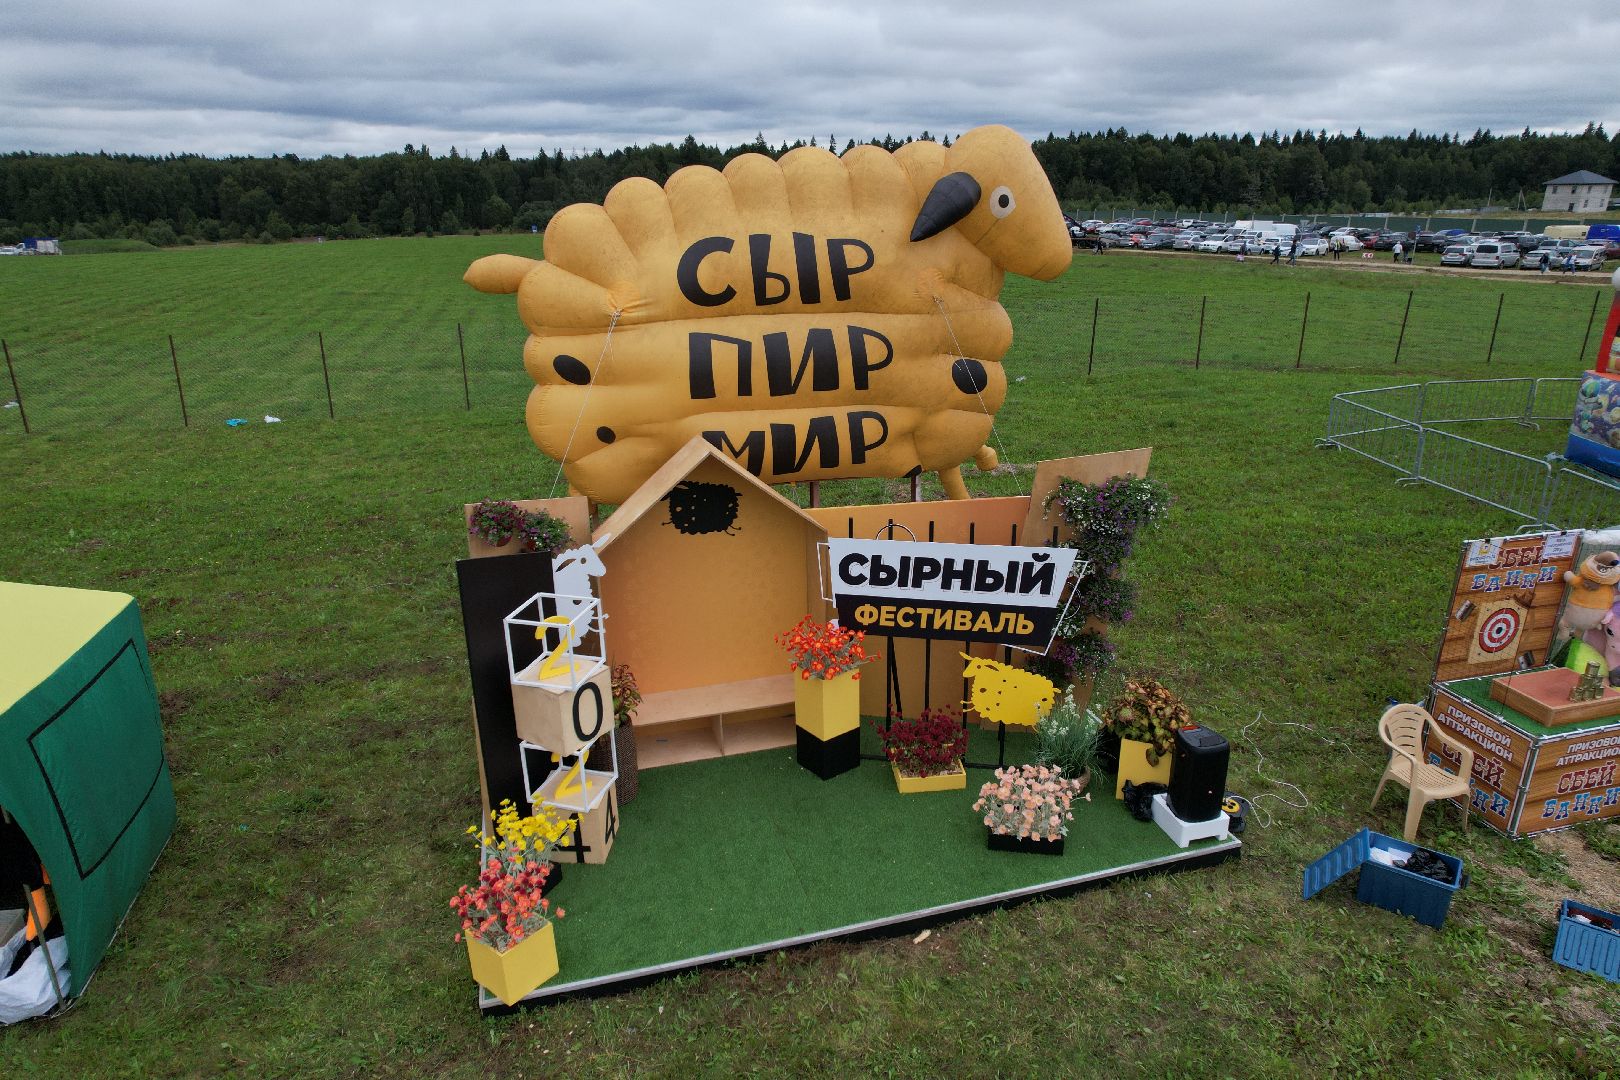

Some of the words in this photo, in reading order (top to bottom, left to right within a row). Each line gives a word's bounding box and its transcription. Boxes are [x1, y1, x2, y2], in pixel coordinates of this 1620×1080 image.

[677, 231, 875, 307] СЫР
[689, 325, 894, 399] ПИР
[702, 410, 889, 478] МИР
[838, 552, 1056, 596] СЫРНЫЙ
[1470, 566, 1557, 593] БАНКИ
[854, 603, 1035, 635] ФЕСТИВАЛЬ
[1437, 712, 1514, 762] АТТРАКЦИОН
[1447, 704, 1512, 747] ПРИЗОВОЙ
[1556, 747, 1620, 767] АТТРАКЦИО
[1557, 760, 1617, 795] СБЕЙ
[1541, 787, 1620, 821] БАНКИ
